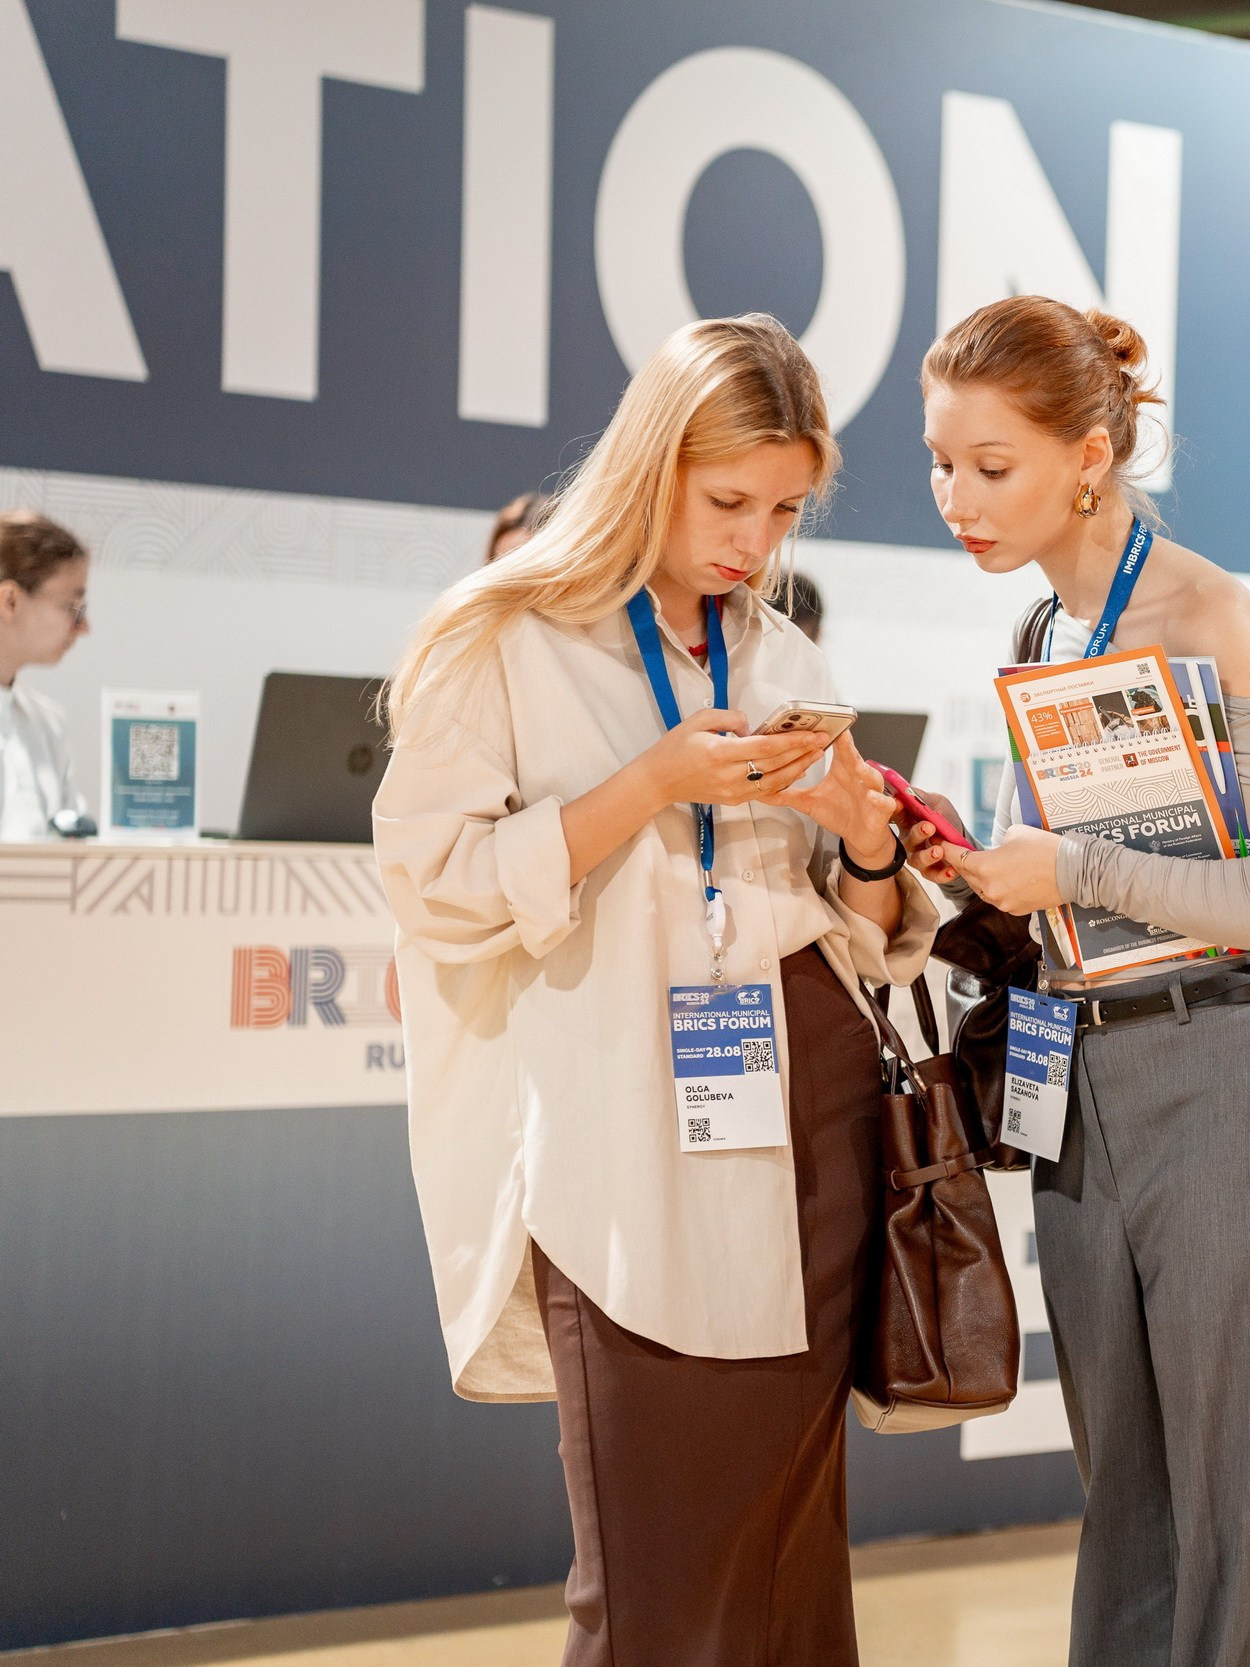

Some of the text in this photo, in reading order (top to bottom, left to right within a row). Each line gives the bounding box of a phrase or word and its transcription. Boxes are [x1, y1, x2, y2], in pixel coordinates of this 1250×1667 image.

[1031, 711, 1053, 722] 43%
[1138, 744, 1181, 758] THE GOVERNMENT
[1147, 755, 1169, 764] MOSCOW
[1036, 764, 1077, 780] BRICS
[1101, 764, 1124, 772] PARTNER
[1142, 805, 1197, 821] MUNICIPAL
[1128, 812, 1202, 840] FORUM
[1096, 914, 1128, 925] ROSCONG
[231, 945, 402, 1029] BRI
[673, 1009, 770, 1019] INTERNATIONAL MUNICIPAL
[673, 1016, 772, 1032] BRICS FORUM
[1010, 1011, 1073, 1035] INTERNATIONAL MUNICIPAL
[1010, 1018, 1072, 1047] BRICS FORUM
[706, 1046, 742, 1058] 28.08
[1026, 1050, 1048, 1067] 28.08
[685, 1085, 710, 1093] OLGA
[1011, 1077, 1040, 1092] ELIZAVETA
[686, 1093, 734, 1102] GOLUBEVA
[1011, 1085, 1039, 1101] SAZANOVA
